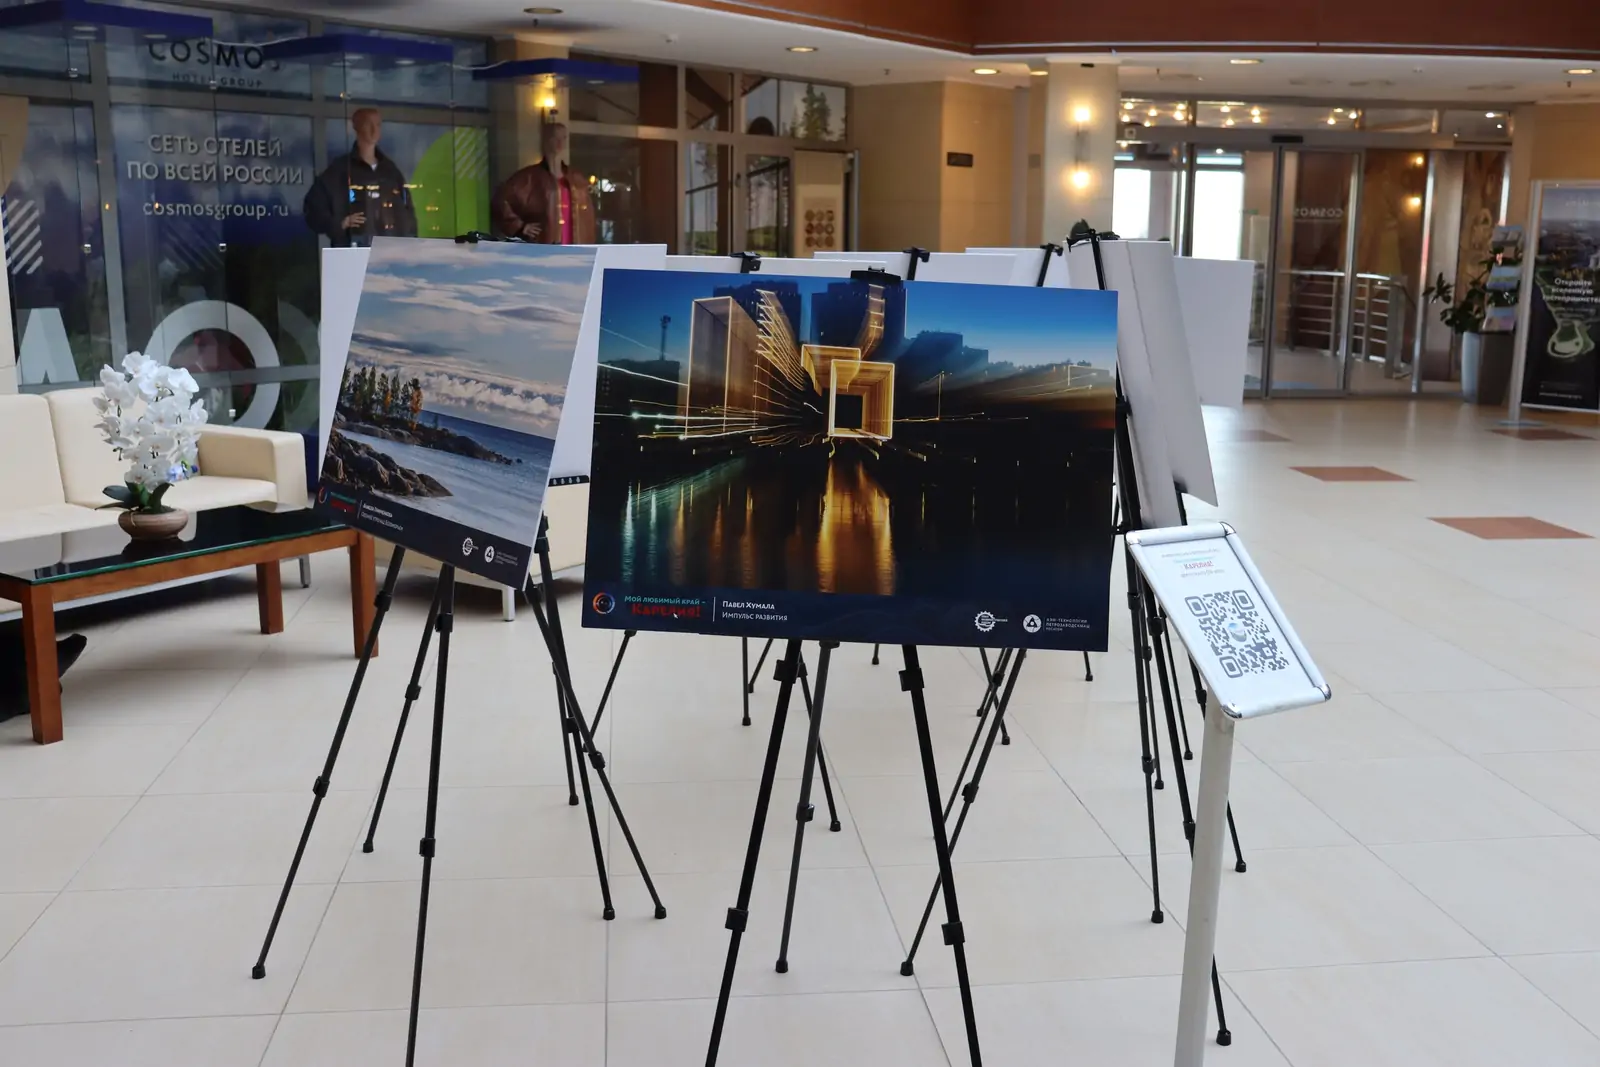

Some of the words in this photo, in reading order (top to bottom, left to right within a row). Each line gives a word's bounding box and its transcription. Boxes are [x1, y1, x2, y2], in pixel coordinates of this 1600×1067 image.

[220, 77, 263, 89] GROUP
[149, 134, 200, 155] СЕТЬ
[203, 137, 281, 158] ОТЕЛЕЙ
[127, 160, 159, 180] ПО
[165, 160, 217, 181] ВСЕЙ
[224, 165, 304, 185] РОССИИ
[143, 201, 289, 220] cosmosgroup.ru
